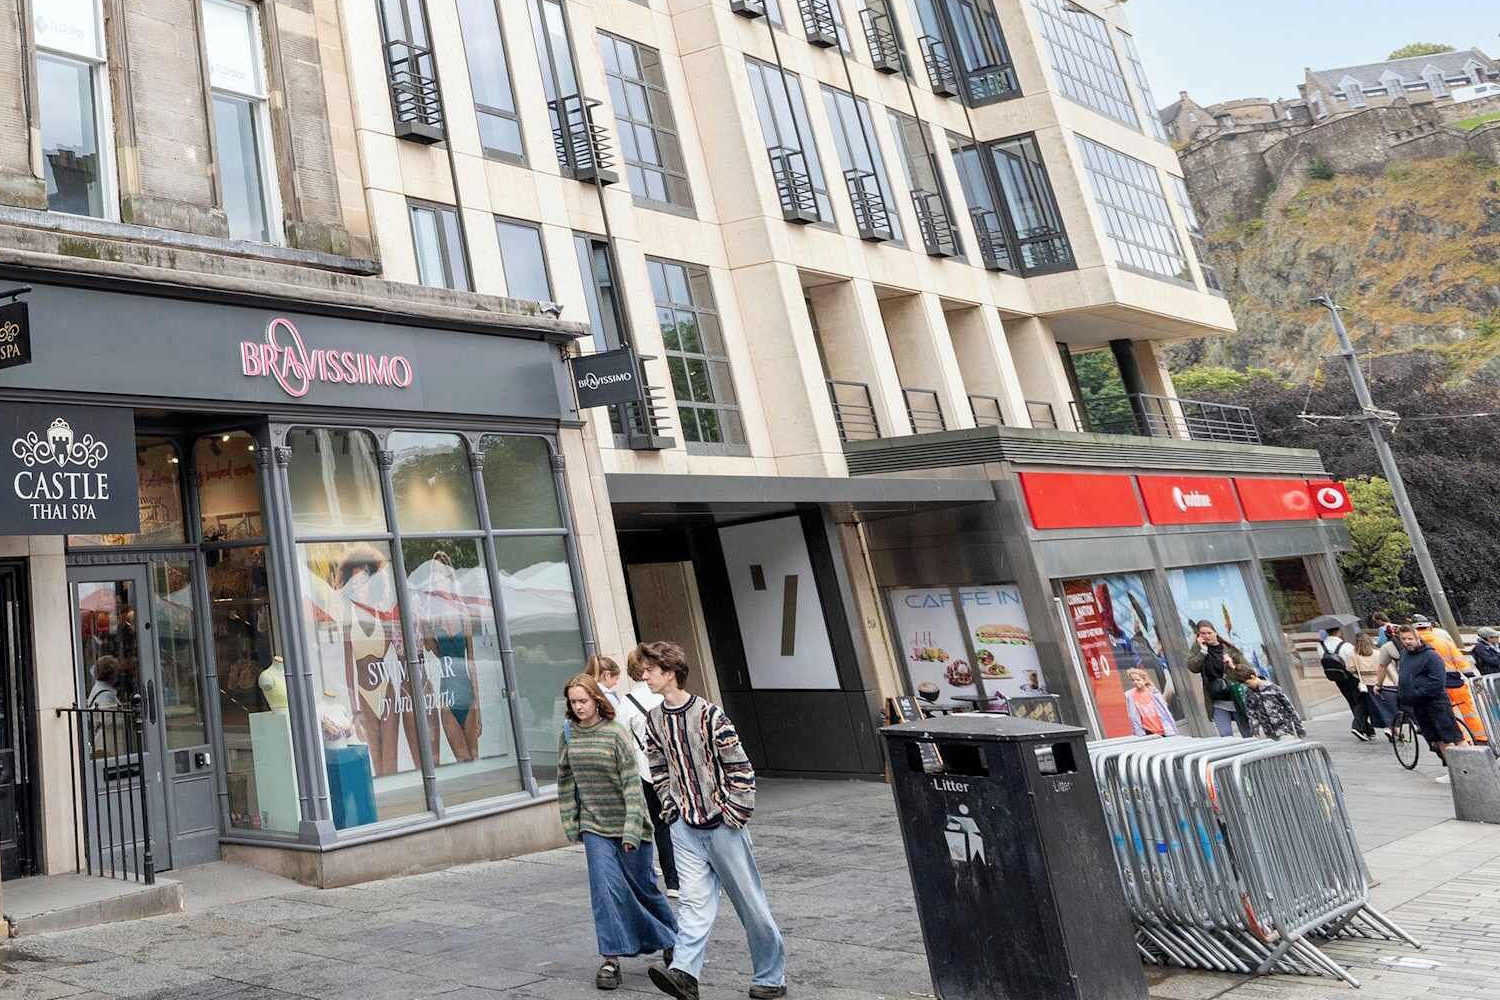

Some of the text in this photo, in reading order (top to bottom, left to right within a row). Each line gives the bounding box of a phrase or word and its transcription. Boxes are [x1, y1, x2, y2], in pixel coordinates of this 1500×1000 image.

[0, 345, 21, 361] SPA
[240, 318, 413, 397] BRAVISSIMO
[578, 372, 632, 390] BRAVISSIMO
[14, 471, 109, 500] CASTLE
[30, 503, 97, 520] THAI SPA
[998, 590, 1020, 605] IN
[933, 778, 970, 793] Litter
